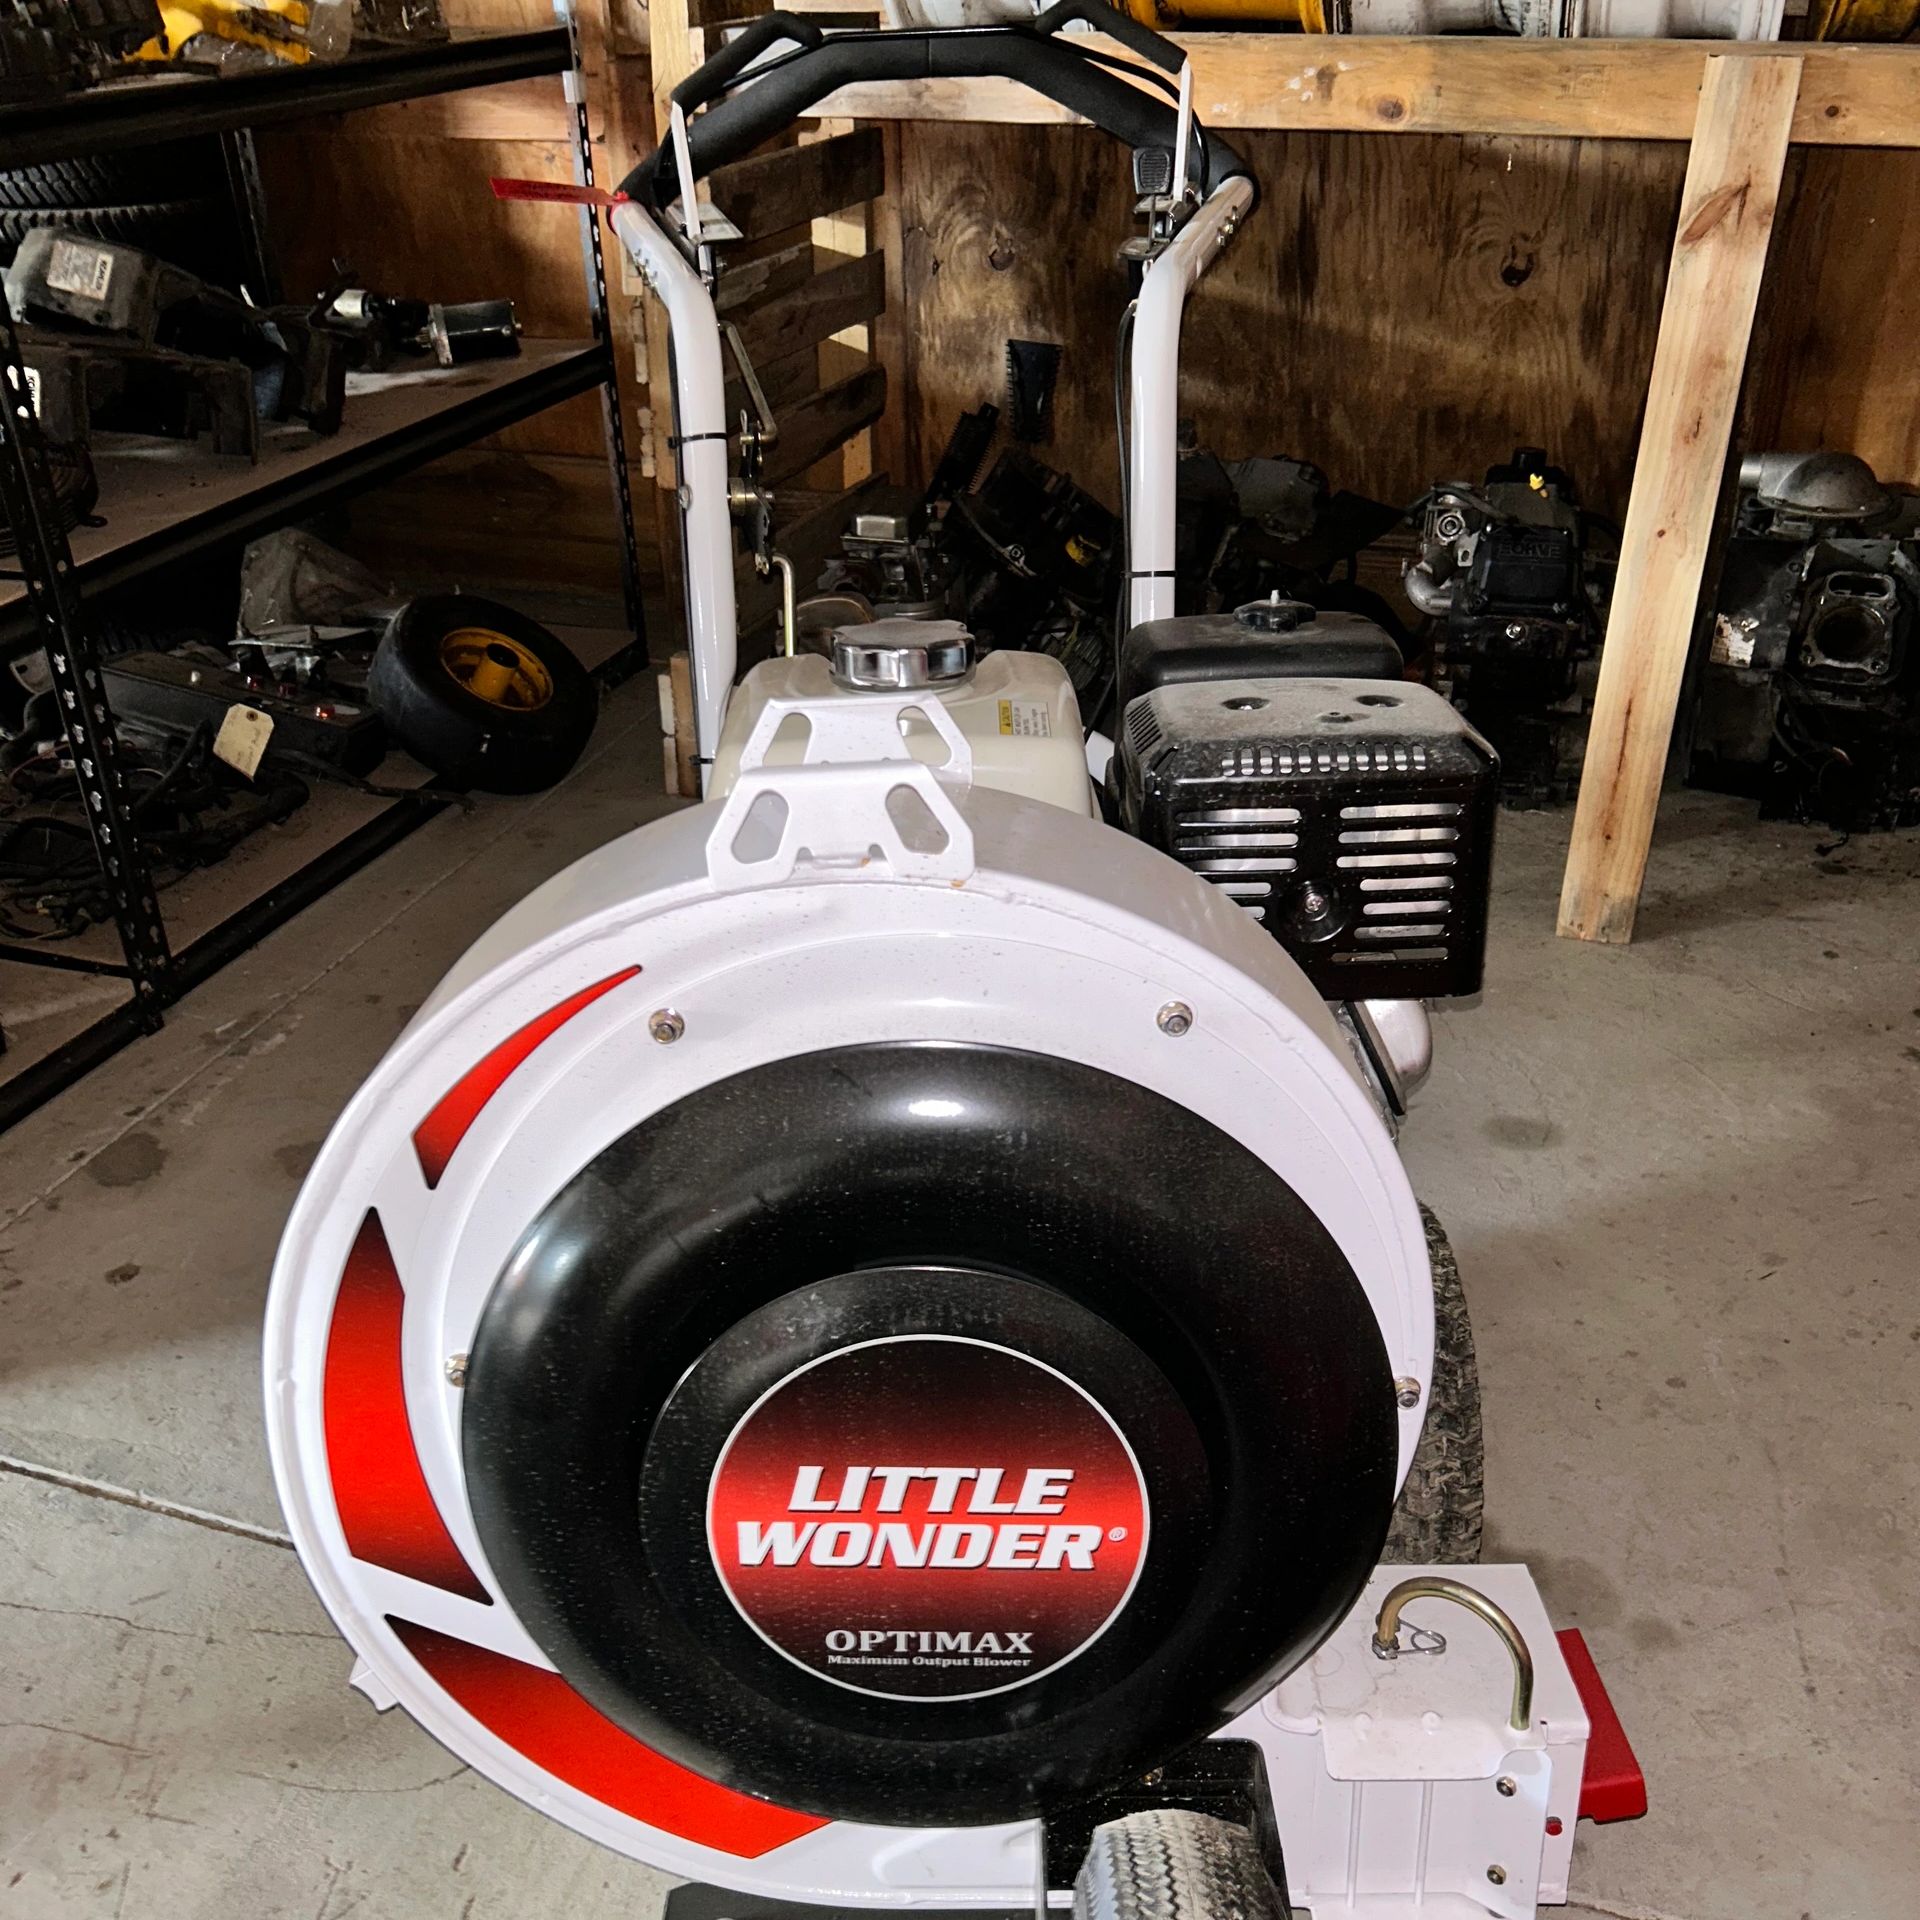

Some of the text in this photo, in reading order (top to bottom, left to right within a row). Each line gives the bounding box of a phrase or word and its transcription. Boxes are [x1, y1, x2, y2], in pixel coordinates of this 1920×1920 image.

[787, 1466, 1074, 1514] LITTLE
[825, 1629, 1034, 1654] OPTIMAX
[827, 1654, 1032, 1668] Maximum Output Blower
